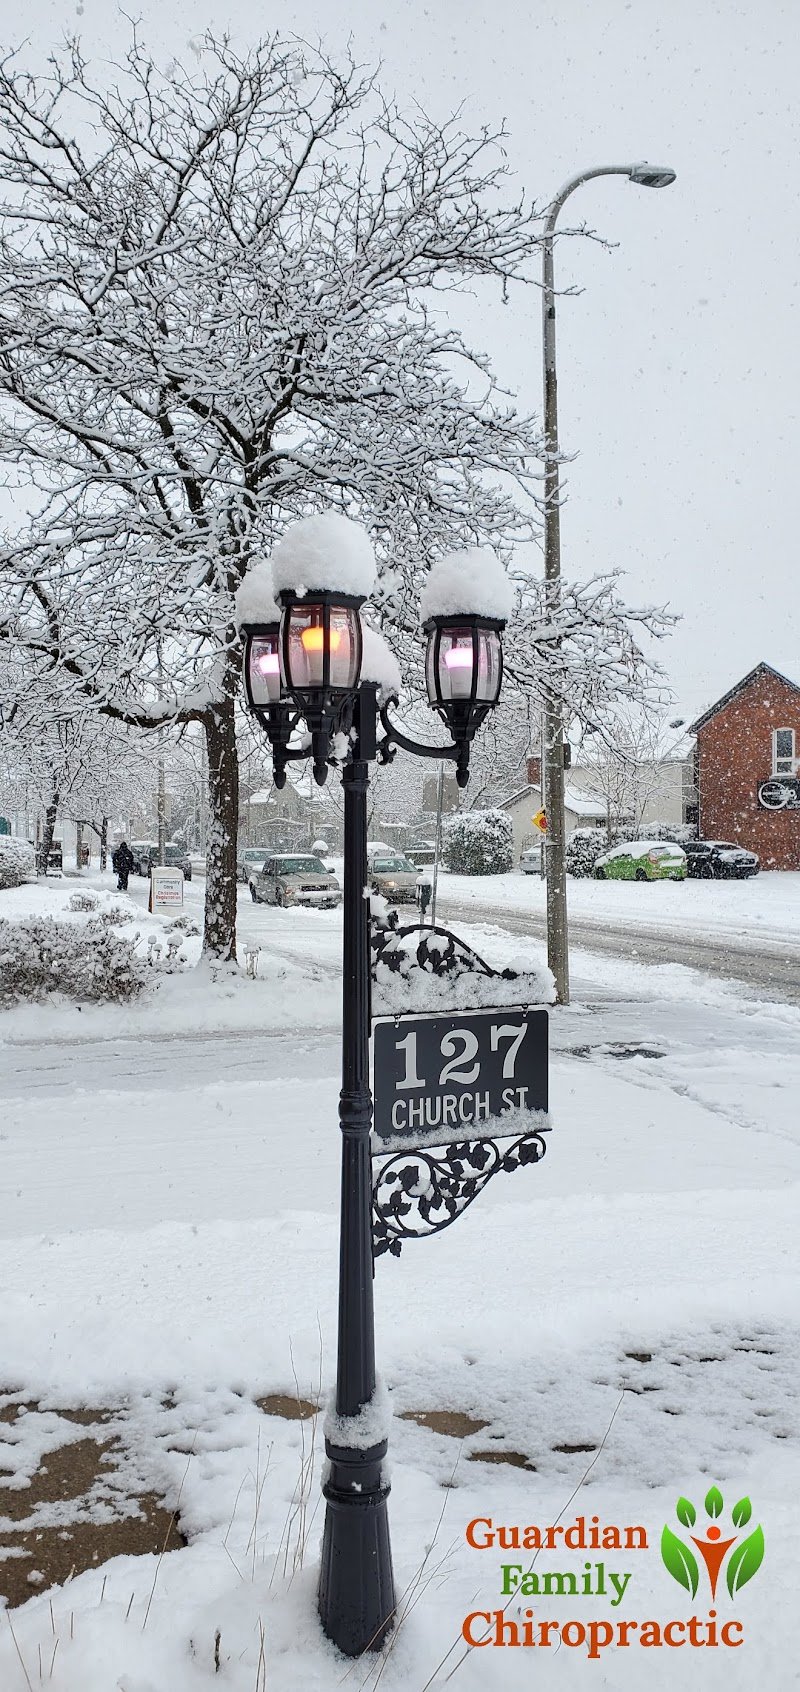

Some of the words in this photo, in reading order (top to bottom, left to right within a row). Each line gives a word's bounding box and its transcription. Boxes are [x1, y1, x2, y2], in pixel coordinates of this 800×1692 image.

[395, 1022, 528, 1090] 127
[391, 1091, 490, 1130] CHURCH
[501, 1086, 529, 1114] ST
